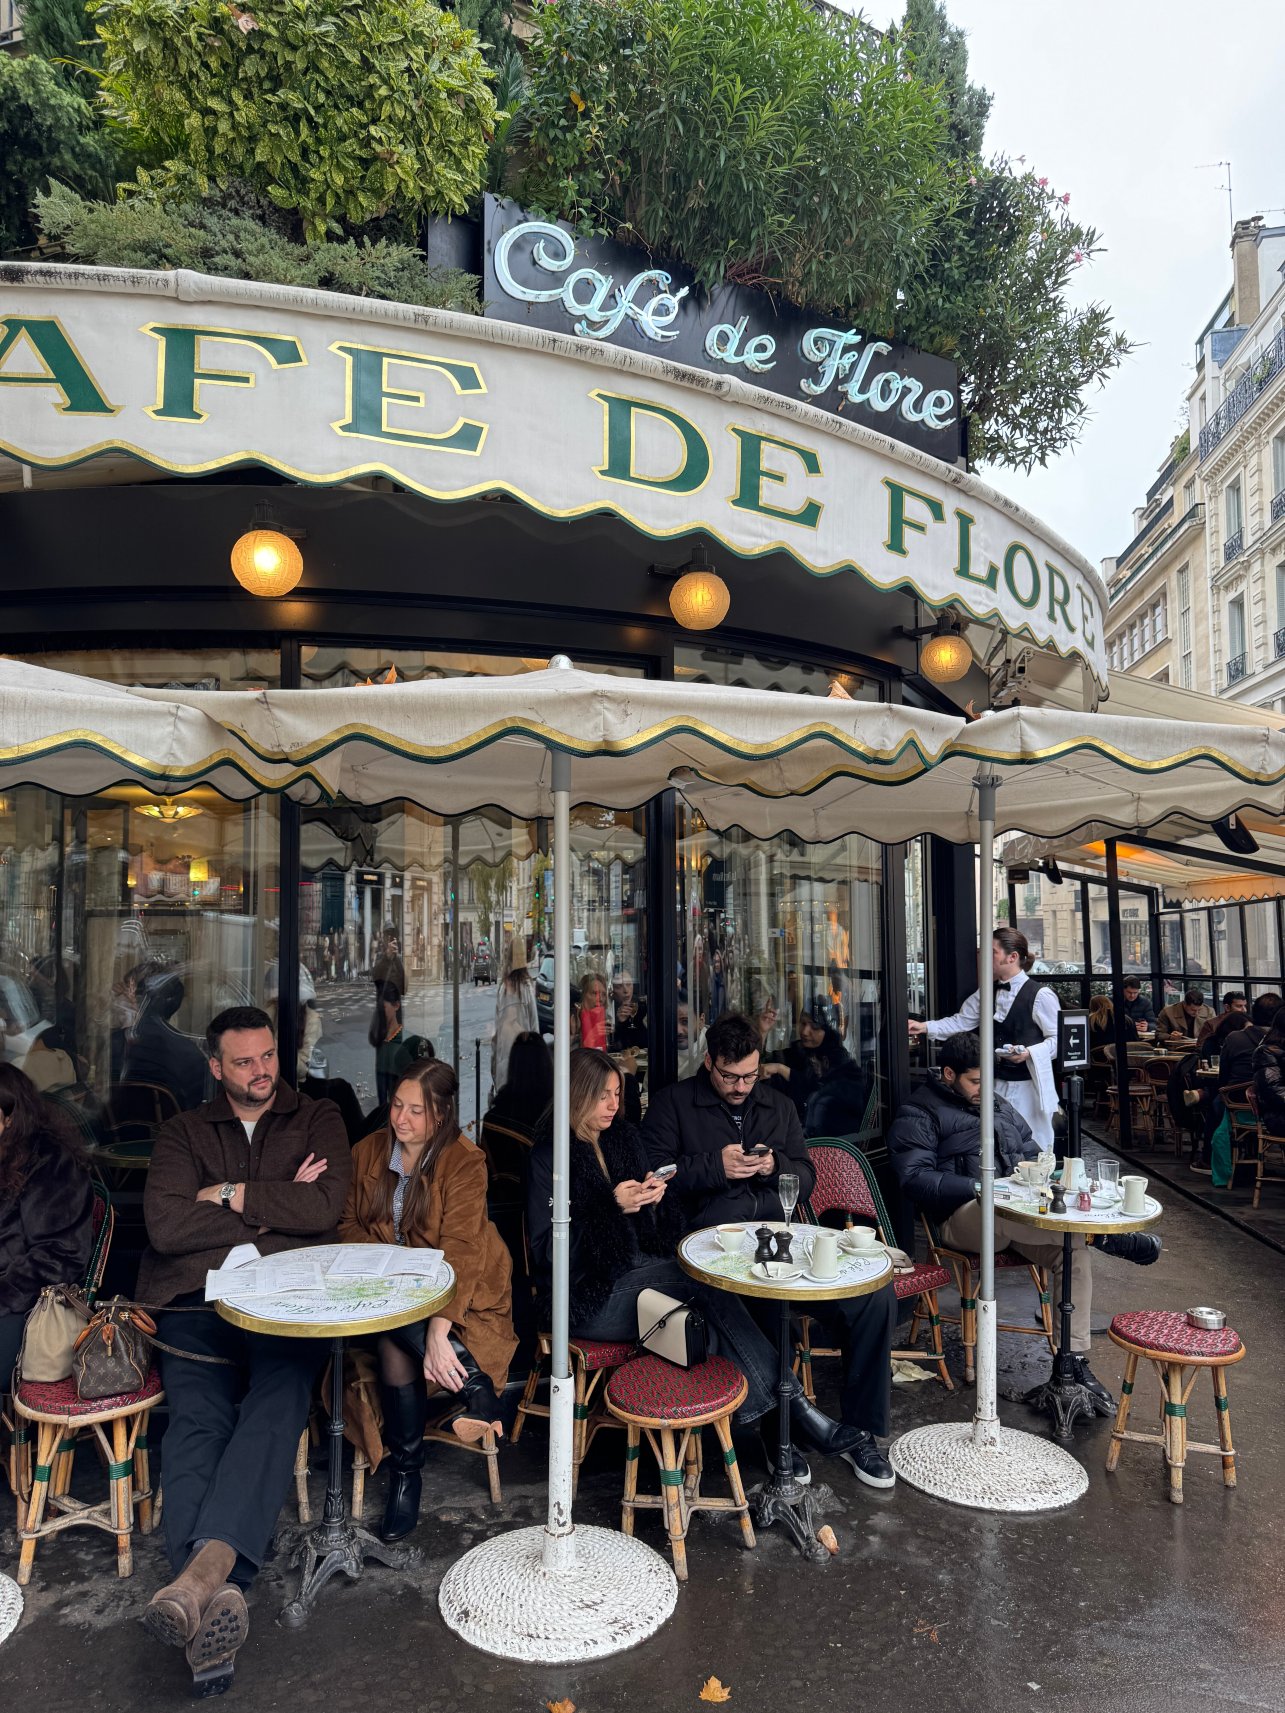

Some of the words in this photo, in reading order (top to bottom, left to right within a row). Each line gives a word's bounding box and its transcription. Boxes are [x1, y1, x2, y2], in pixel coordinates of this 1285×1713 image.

[494, 221, 689, 342] Café
[704, 315, 777, 374] de
[799, 326, 957, 431] Flore
[587, 387, 825, 531] DE
[880, 475, 1095, 654] FLORE
